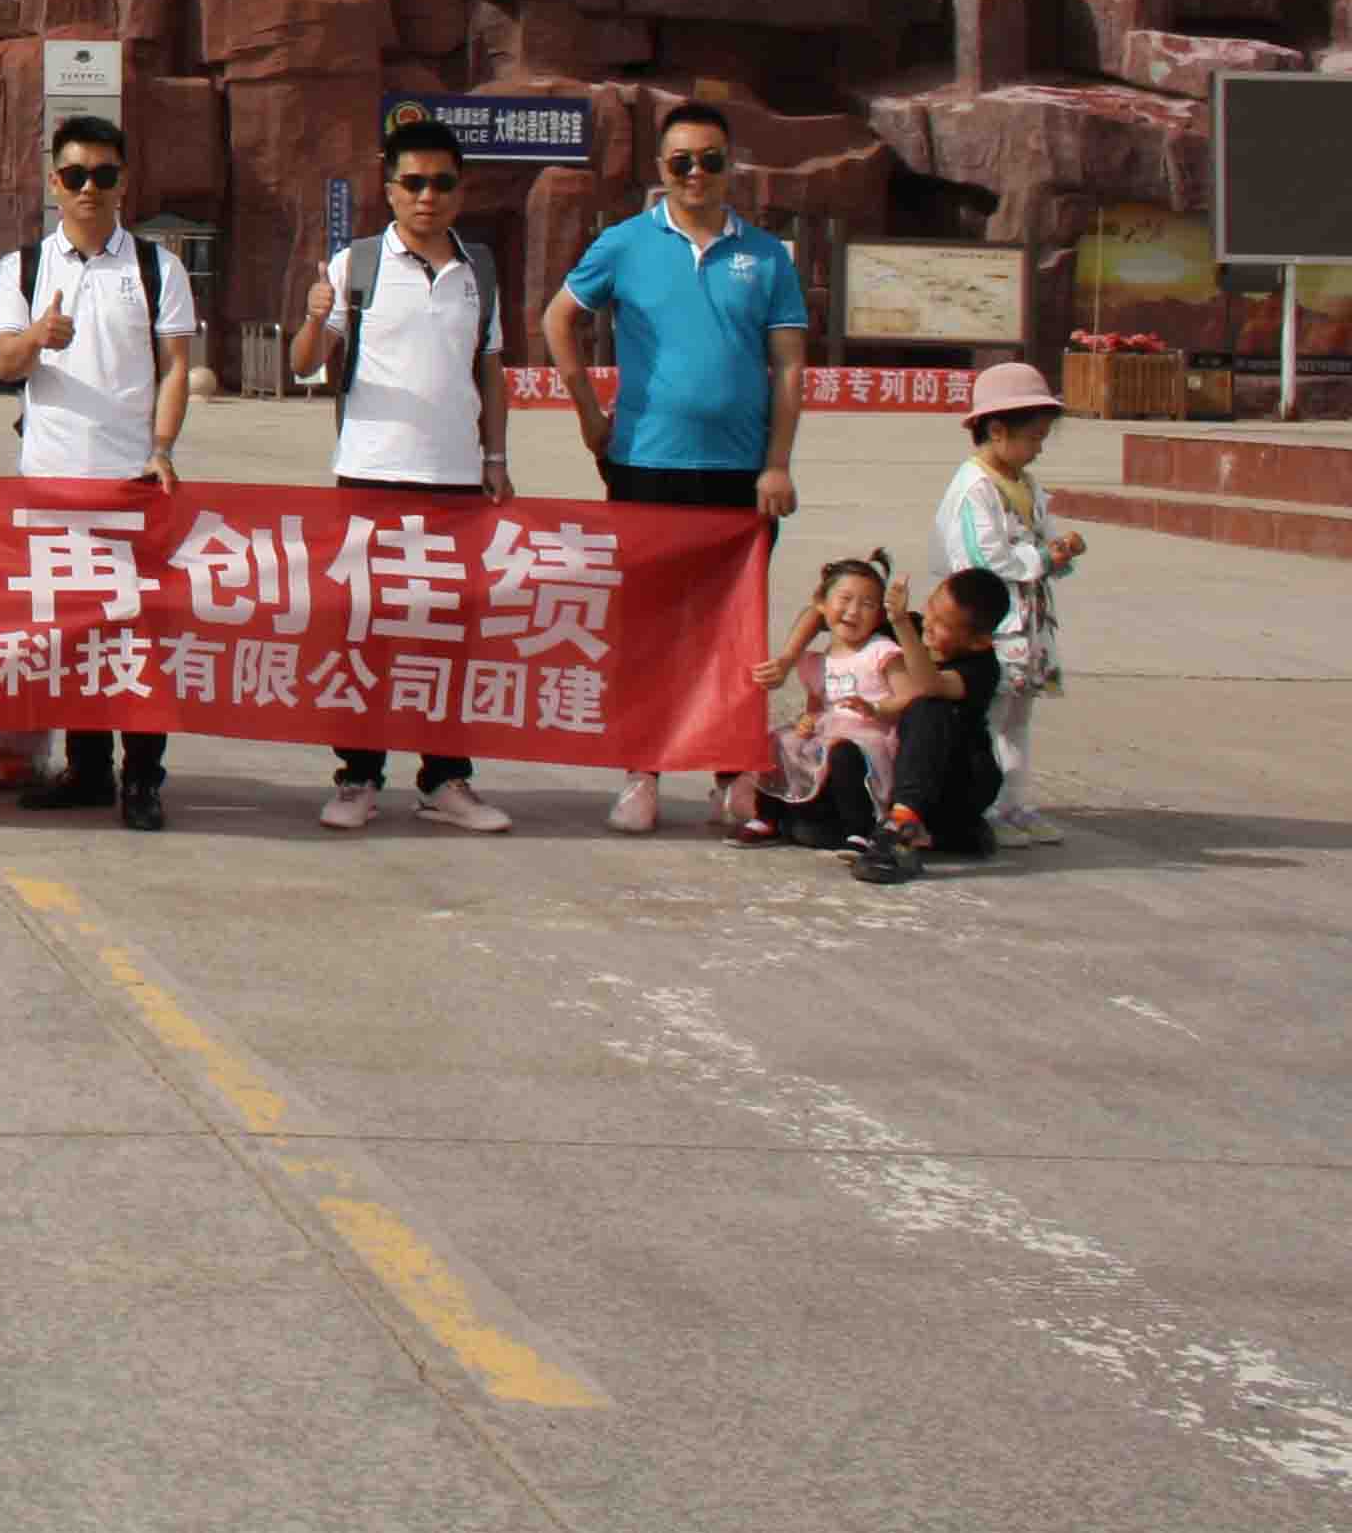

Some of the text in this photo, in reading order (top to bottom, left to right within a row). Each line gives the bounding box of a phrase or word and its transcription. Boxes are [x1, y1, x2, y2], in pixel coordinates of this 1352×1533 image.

[455, 129, 489, 143] LICE
[801, 368, 973, 403] 游专列的贵
[8, 508, 623, 661] 再创佳绩
